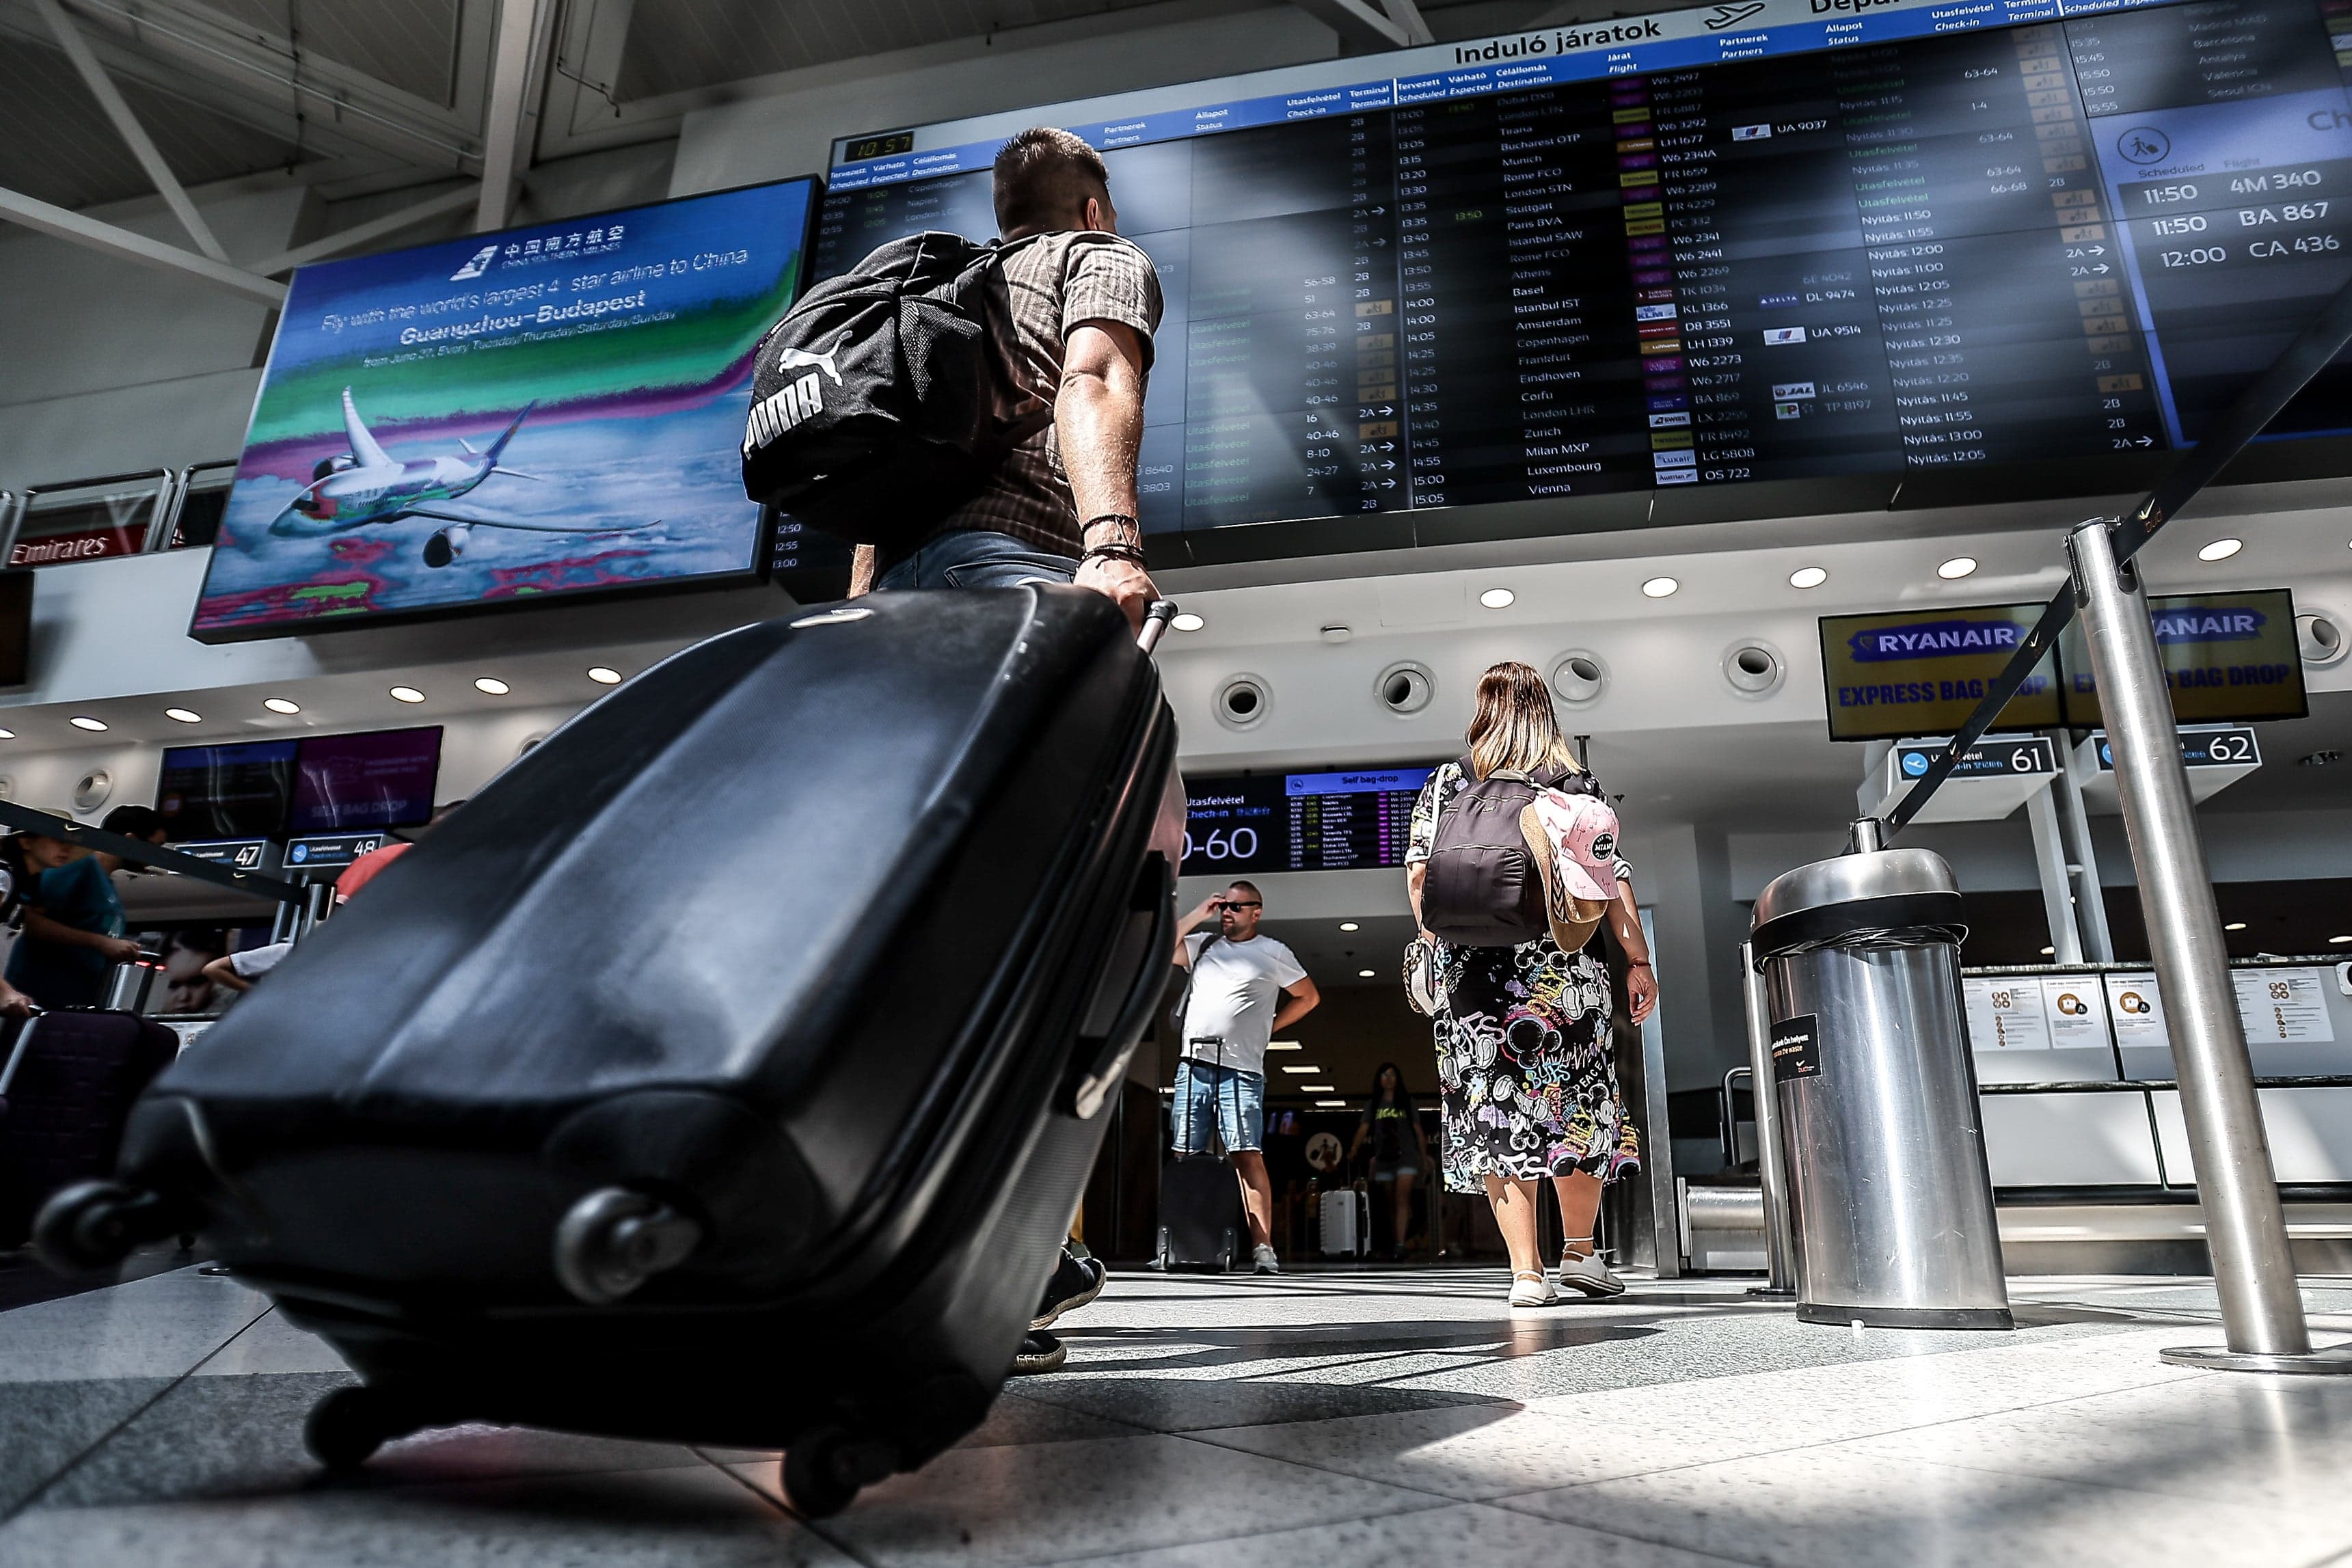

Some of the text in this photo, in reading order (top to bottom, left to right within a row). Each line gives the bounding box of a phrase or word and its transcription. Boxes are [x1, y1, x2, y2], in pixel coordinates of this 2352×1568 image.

[1931, 4, 1994, 18] Utasfelvétel
[2008, 8, 2054, 21] Terminal
[1826, 22, 1863, 33] Állapot
[1935, 18, 1980, 31] Check-in
[1455, 19, 1662, 64] Induló járatok
[1720, 33, 1768, 47] Partnerek
[1828, 35, 1859, 46] Status
[1608, 52, 1631, 62] Járat
[1722, 46, 1763, 59] Partners
[1609, 64, 1637, 74] Flight
[1398, 64, 1547, 91] Tervezett Várható Célállomás
[1398, 75, 1552, 103] Scheduled Expected Destination
[1286, 85, 1390, 107] Utasfelvétel Terminál
[1287, 98, 1390, 118] Check-in Terminal
[1104, 122, 1146, 134] Partnerek
[1195, 122, 1223, 131] Status
[1498, 126, 1532, 137] Tirana
[1777, 120, 1828, 133] UA 9037
[1104, 135, 1139, 145] Partners
[1500, 133, 1581, 152] Bucharest OTP
[859, 141, 877, 157] 10
[1502, 155, 1542, 167] Munich
[911, 163, 959, 176] Destination
[1504, 168, 1562, 183] Rome FCO
[2139, 164, 2205, 179] Scheduled
[2230, 170, 2323, 194] 4M 340
[1504, 183, 1573, 200] London STN
[2144, 185, 2198, 204] 11:50
[1506, 202, 1553, 215] Stuttgart
[2239, 202, 2329, 227] BA 867
[1507, 217, 1563, 231] Paris BVA
[2152, 216, 2208, 236] 11:50
[504, 225, 625, 258] 中国南方航空
[1509, 230, 1584, 247] Istanbul SAW
[2249, 235, 2340, 258] CA 436
[1510, 249, 1570, 263] Rome FCO
[2161, 247, 2227, 268] 12:00
[1511, 268, 1552, 280] Athens
[321, 314, 344, 334] Fly
[389, 305, 416, 321] the
[483, 283, 544, 306] largest
[547, 280, 558, 292] 4
[571, 273, 604, 292] star
[610, 262, 664, 286] airline
[670, 258, 687, 274] to
[692, 249, 748, 271] China
[1513, 286, 1544, 297] Basel
[1406, 298, 1435, 308] 14:00
[1515, 298, 1580, 314] Istanbul IST
[1407, 314, 1435, 325] 14:00
[1516, 316, 1582, 331] Amsterdam
[1407, 332, 1435, 342] 14:05
[1517, 334, 1590, 349] Copenhagen
[1518, 353, 1571, 366] Frankfurt
[1520, 370, 1581, 383] Eindhoven
[1522, 392, 1554, 403] Corfu
[1307, 414, 1318, 423] 16
[1360, 409, 1375, 418] 2A
[2108, 418, 2126, 429] 2B
[1306, 430, 1340, 440] 40-46
[1524, 427, 1561, 438] Zurich
[1360, 444, 1377, 453] 2A
[1526, 443, 1590, 457] Milan MXP
[2113, 438, 2132, 449] 2A
[1307, 448, 1330, 458] 8-10
[1414, 457, 1441, 467] 14:55
[1144, 464, 1173, 476] 8640
[1307, 466, 1338, 476] 24-27
[1527, 462, 1601, 476] Luxembourg
[1705, 468, 1750, 480] OS 722
[1414, 474, 1445, 486] 15:00
[1143, 483, 1170, 493] 3803
[1528, 483, 1571, 495] Vienna
[1362, 500, 1377, 509] 2B
[777, 524, 802, 534] 12:50
[10, 537, 110, 564] Emirates
[775, 541, 798, 552] 12:55
[2152, 614, 2255, 636] ANAIR
[1879, 628, 2015, 652] RYANAIR
[2179, 666, 2223, 688] BAG
[2230, 664, 2290, 686] DROP
[1838, 675, 2047, 707] EXPRESS BAG OP
[2208, 735, 2252, 761] 62
[2011, 746, 2042, 772] 61
[1342, 774, 1398, 785] Self bag-drop
[1185, 796, 1244, 806] Utasfelvétel
[353, 840, 376, 856] 48
[234, 846, 260, 865] 47
[1574, 1060, 1603, 1094] PEACE
